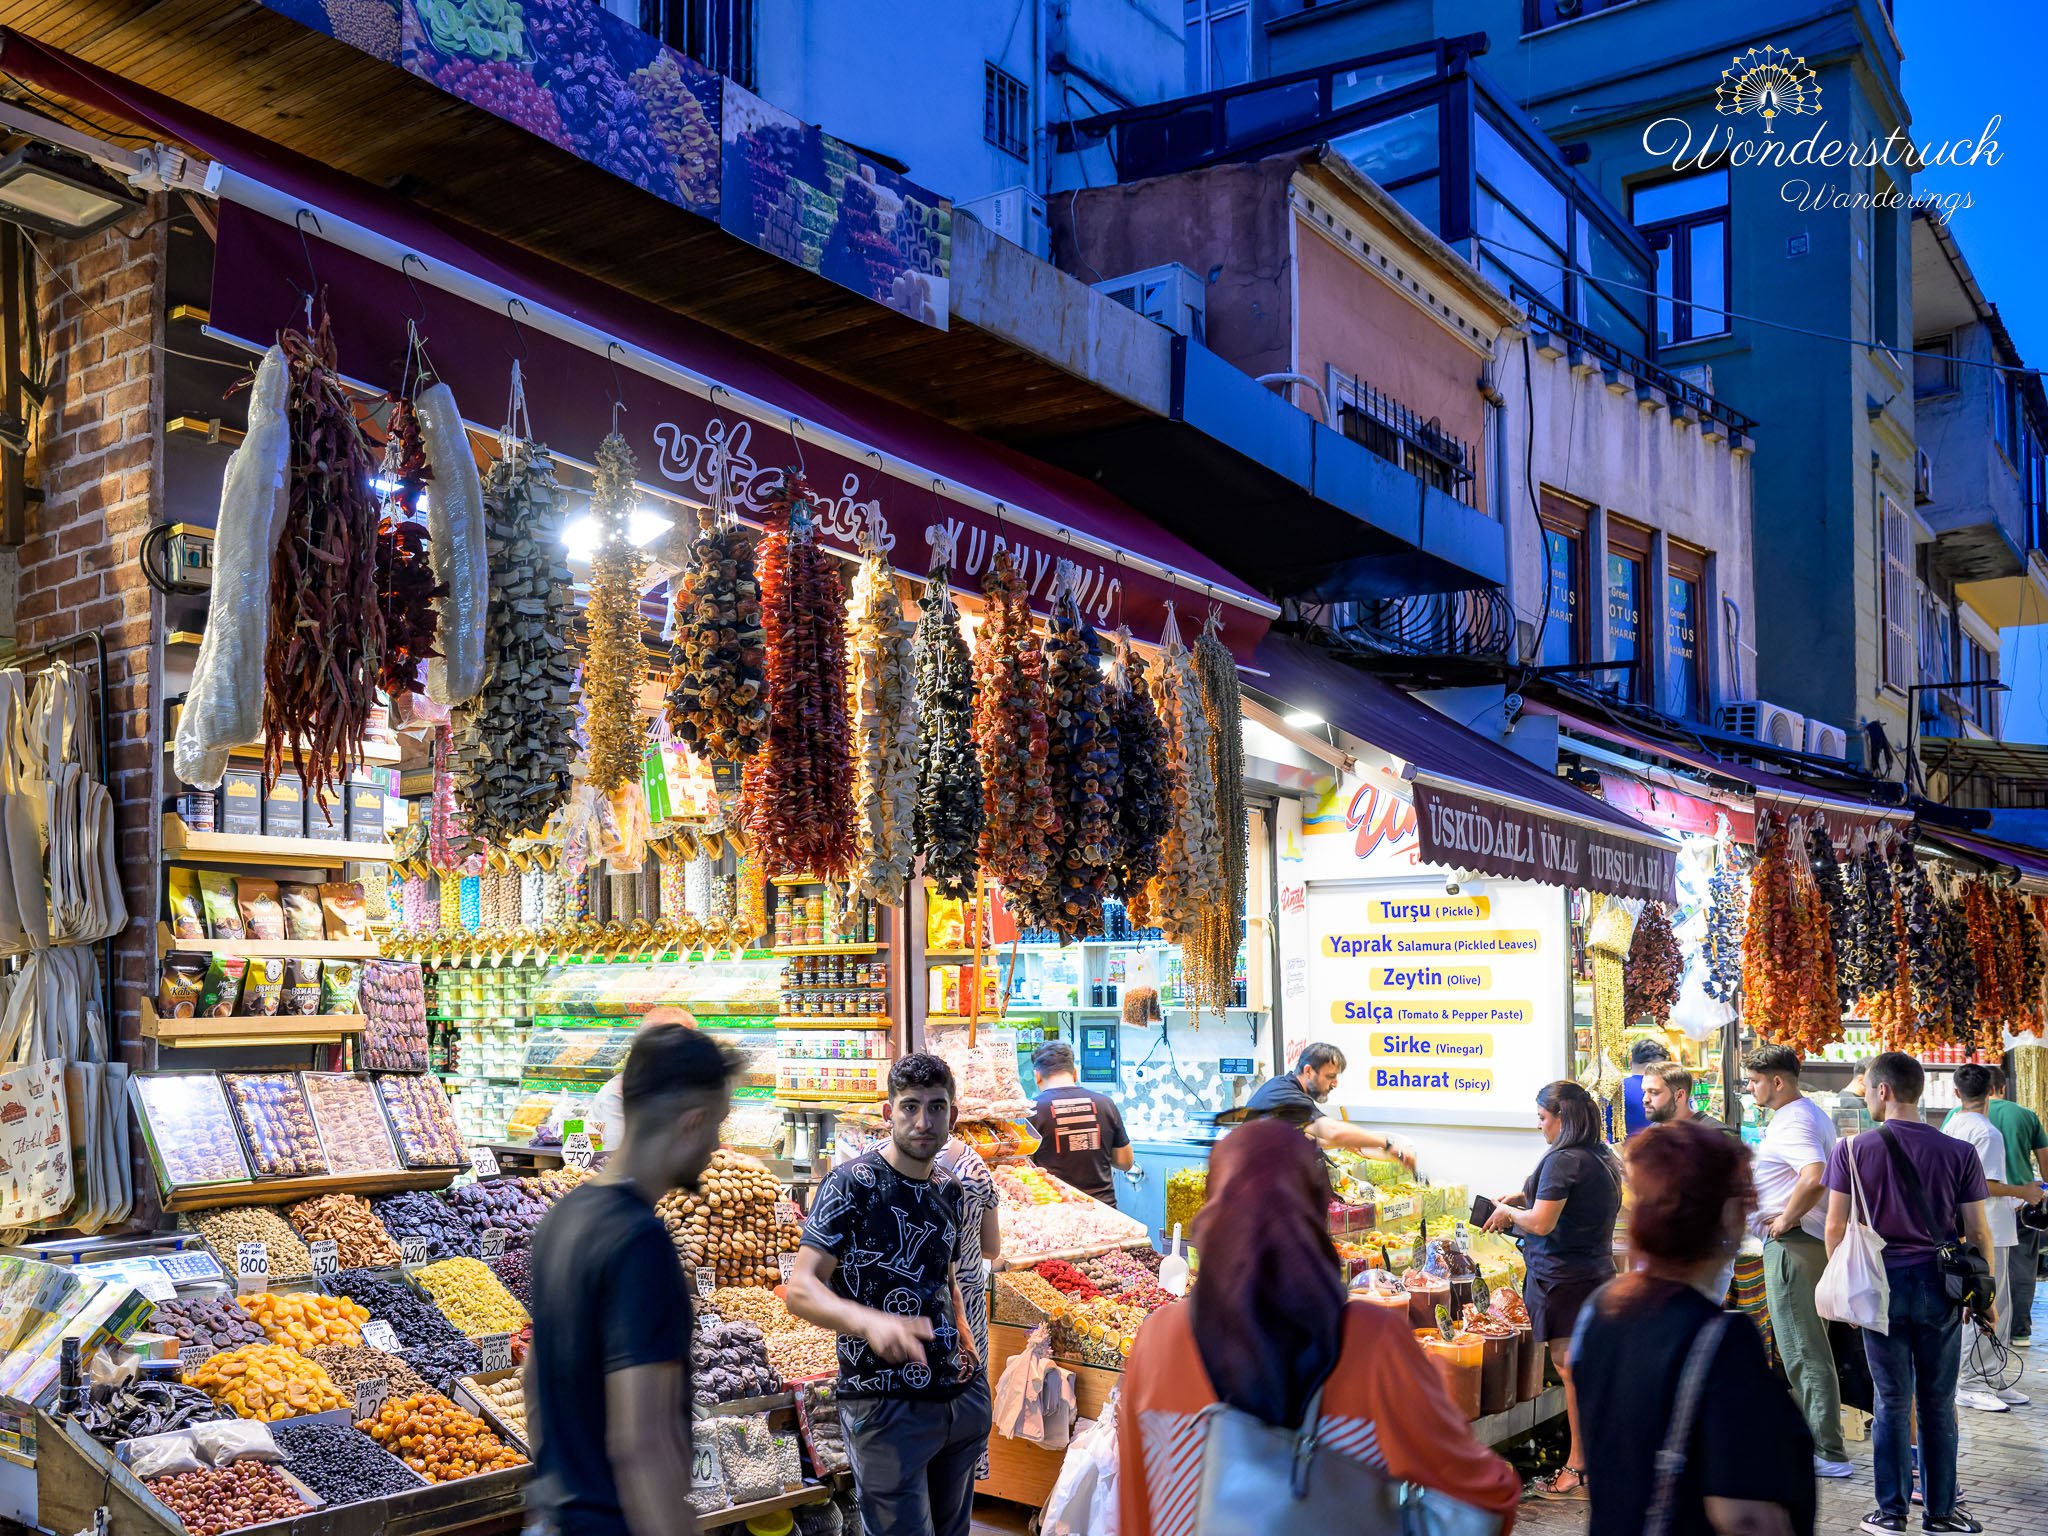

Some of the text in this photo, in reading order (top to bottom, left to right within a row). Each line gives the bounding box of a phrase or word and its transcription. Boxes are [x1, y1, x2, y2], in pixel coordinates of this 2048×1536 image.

[1540, 824, 1580, 875] ÜNAL
[1588, 843, 1660, 891] TURŞULARI
[1380, 901, 1430, 922] Turşu
[1330, 934, 1537, 957] Yaprak Salamura (Pickled Leaves)
[1383, 967, 1481, 990] Zeytin (Olive)
[1344, 1001, 1523, 1024] Salça (Tomato & Pepper Paste)
[1383, 1035, 1483, 1057] Sirke (Vinegar)
[1376, 1069, 1490, 1091] Baharat (Spicy)
[475, 1159, 497, 1174] 850
[565, 1151, 592, 1170] 750
[777, 1212, 794, 1225] 720
[402, 1245, 426, 1264] 420
[482, 1239, 504, 1257] 520
[240, 1256, 267, 1273] 800
[314, 1255, 337, 1276] 450
[485, 1354, 507, 1372] 800
